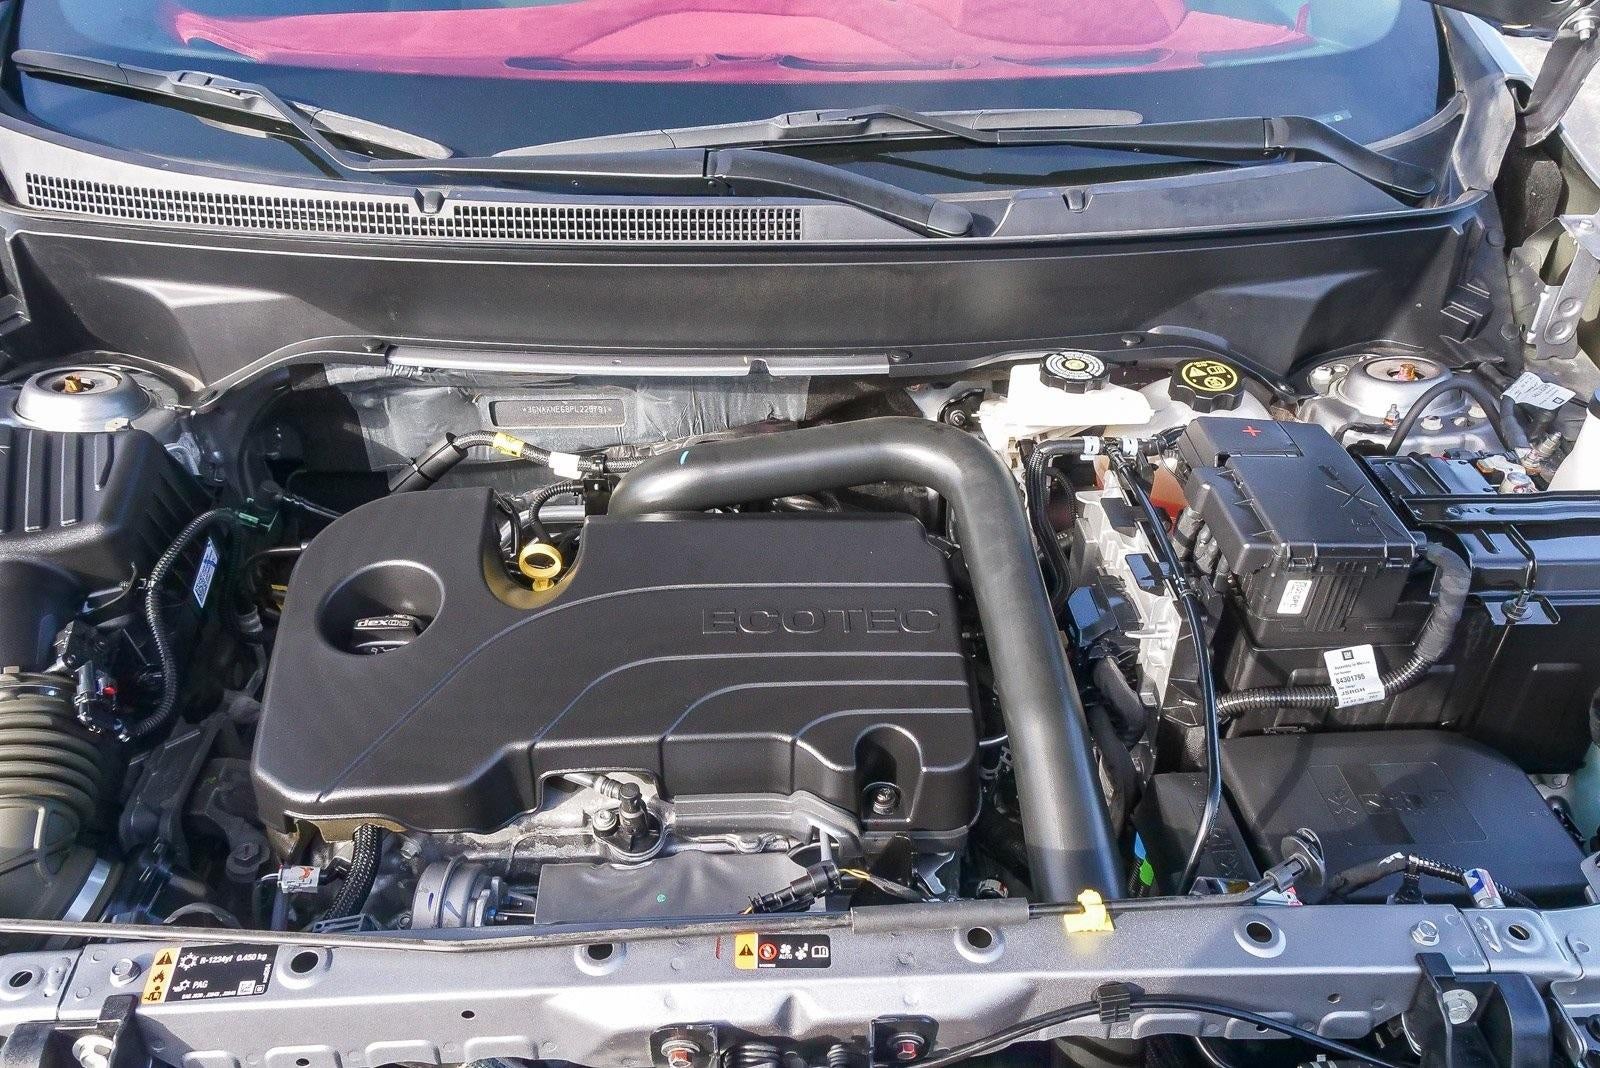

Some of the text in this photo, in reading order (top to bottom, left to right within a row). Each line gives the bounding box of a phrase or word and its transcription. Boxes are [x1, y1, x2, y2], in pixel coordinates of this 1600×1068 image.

[357, 619, 410, 627] dexos
[702, 608, 940, 635] ECOTEC
[200, 955, 233, 964] R-1234yf
[257, 953, 268, 962] kg
[192, 981, 208, 989] PAG
